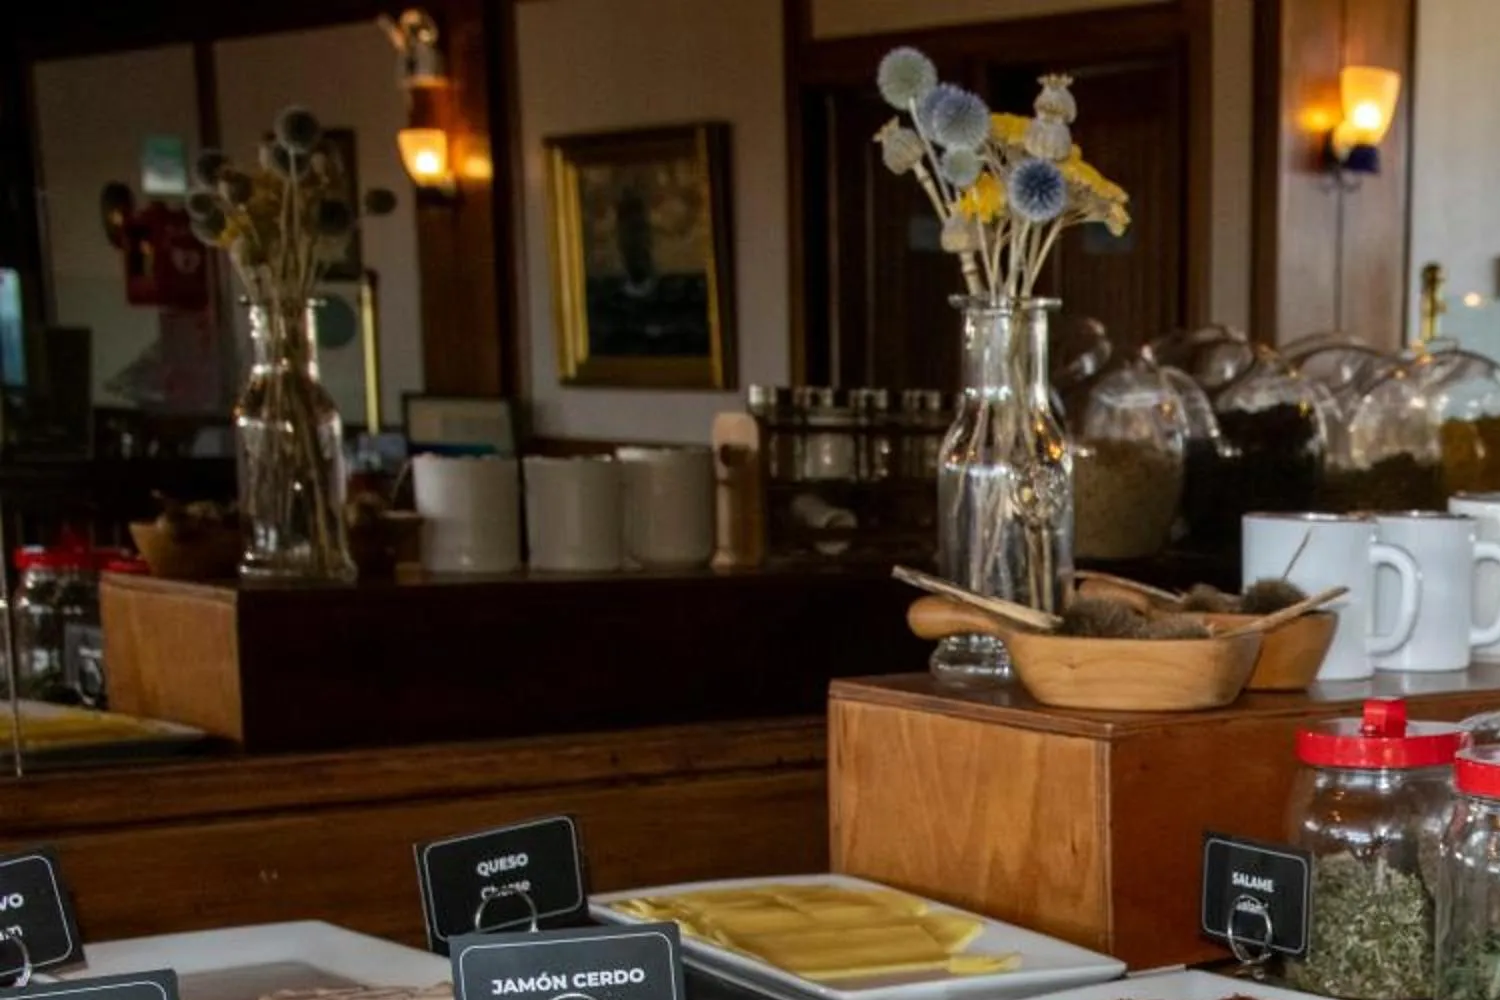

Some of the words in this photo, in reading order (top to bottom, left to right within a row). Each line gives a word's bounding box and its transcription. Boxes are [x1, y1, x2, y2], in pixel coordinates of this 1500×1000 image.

[477, 852, 528, 877] QUESO
[491, 971, 568, 995] JAMÓN
[573, 967, 645, 988] CERDO
